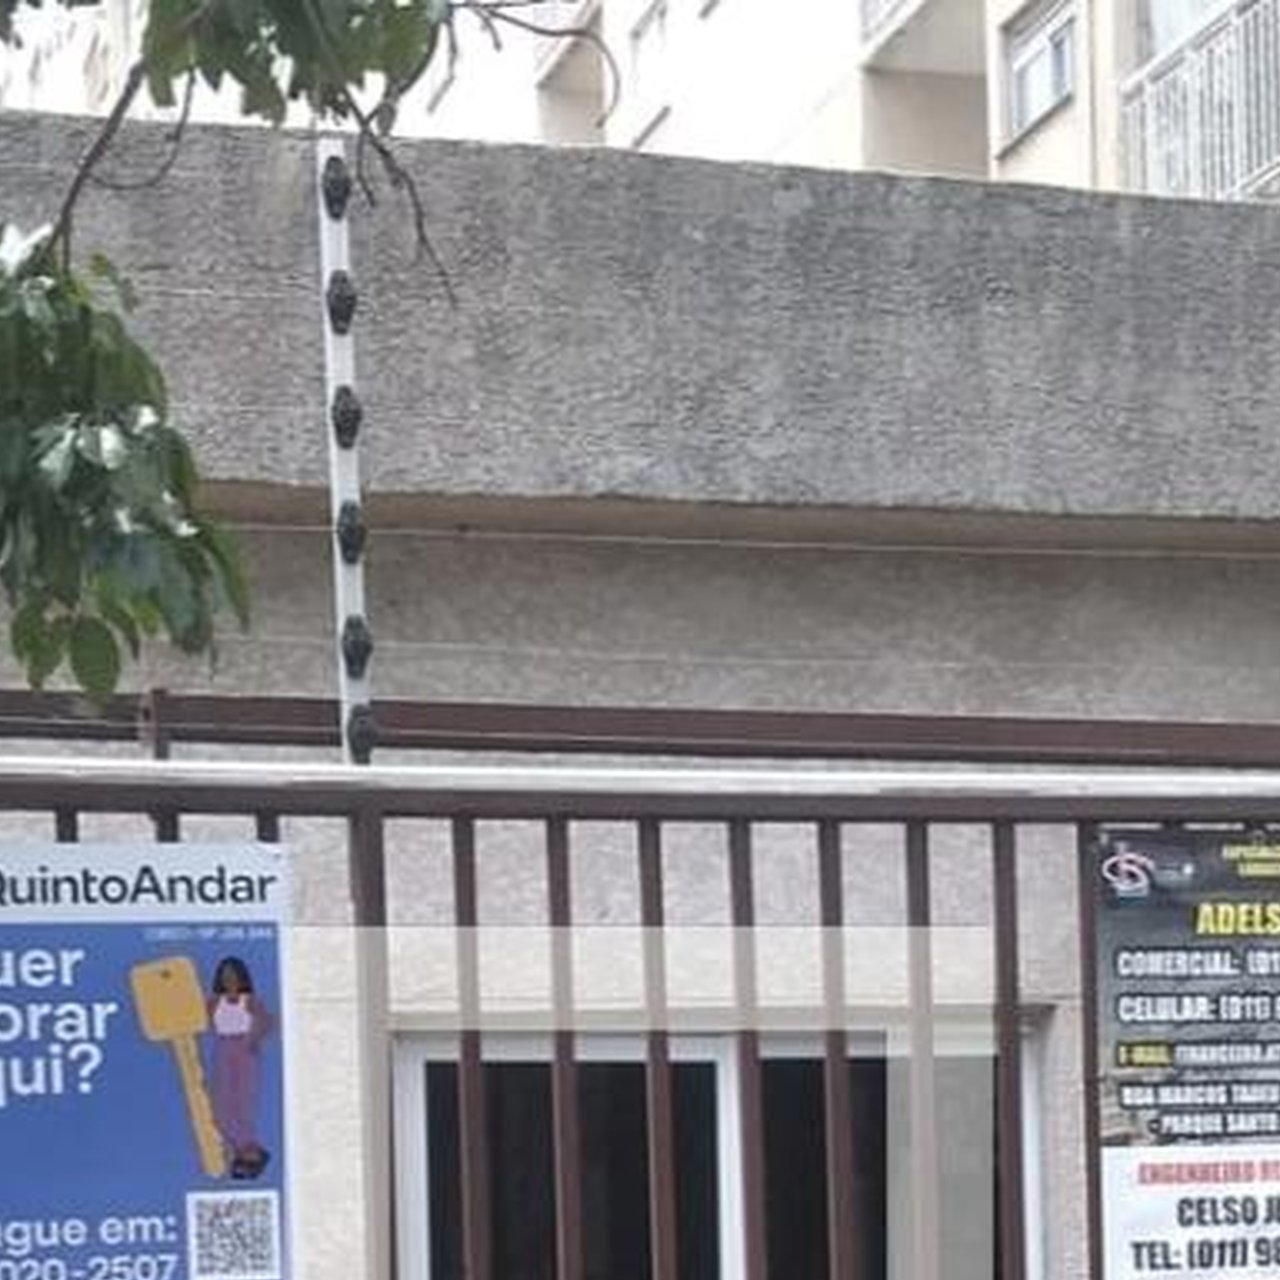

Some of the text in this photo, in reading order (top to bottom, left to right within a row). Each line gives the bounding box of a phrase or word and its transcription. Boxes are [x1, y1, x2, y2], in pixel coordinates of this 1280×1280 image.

[1177, 1195, 1259, 1227] CELSO
[100, 1213, 178, 1243] em:
[1131, 1239, 1182, 1270] TEL:
[1187, 1238, 1249, 1270] (011)
